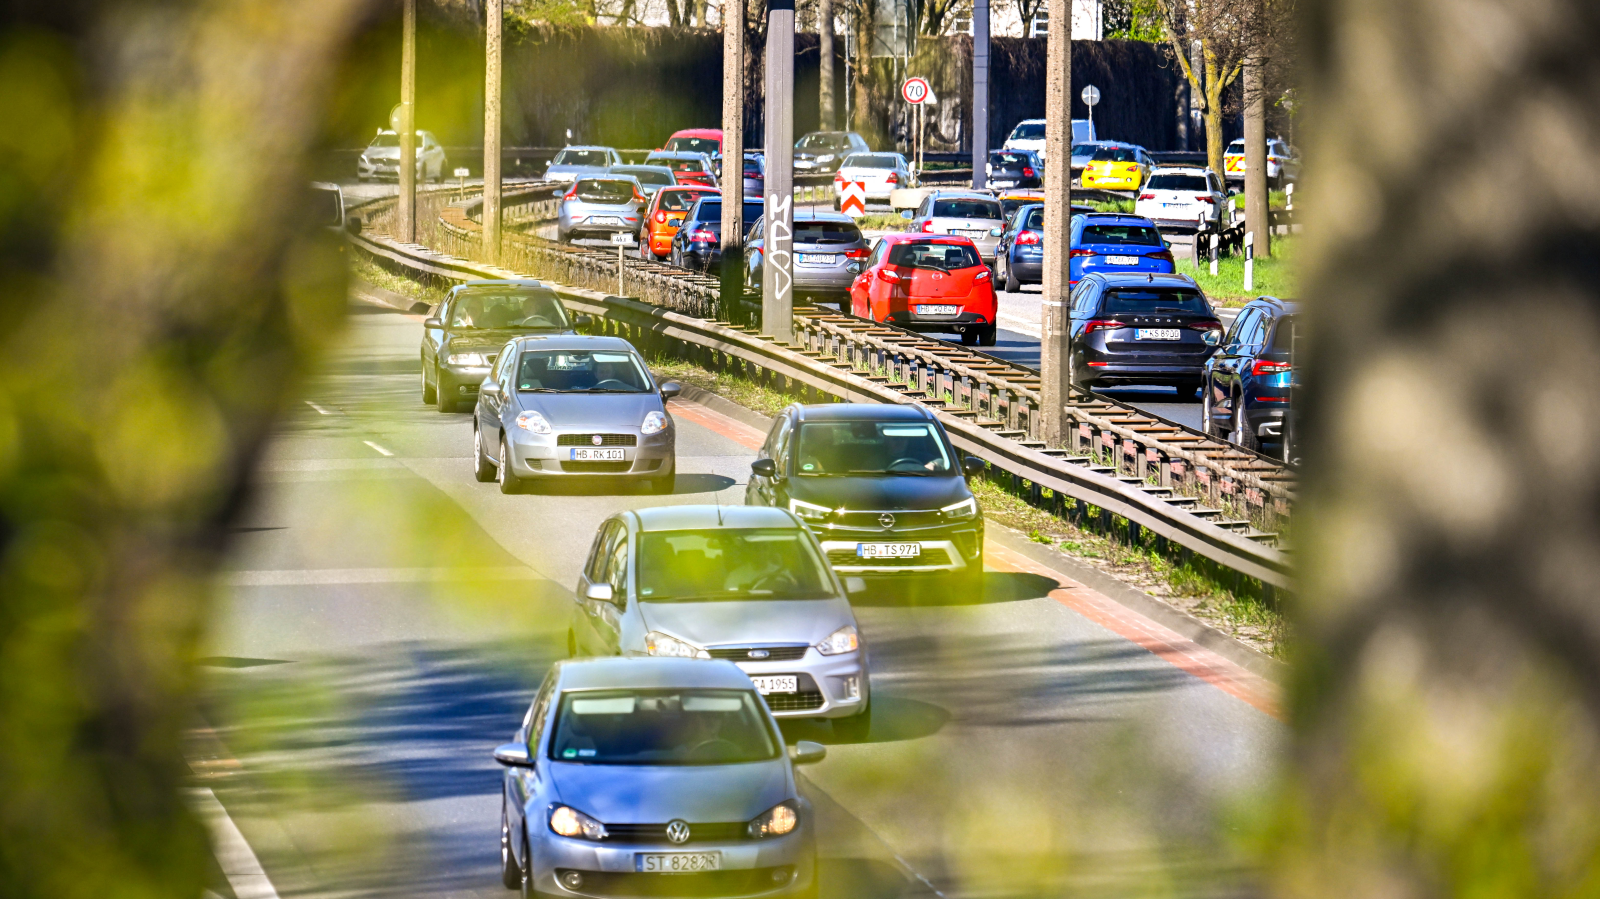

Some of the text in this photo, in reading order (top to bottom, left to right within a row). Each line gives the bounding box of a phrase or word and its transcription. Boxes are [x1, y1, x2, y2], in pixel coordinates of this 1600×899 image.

[908, 85, 923, 97] 70
[1149, 329, 1159, 338] KS
[576, 450, 623, 459] HB RK 101
[863, 545, 919, 555] HB TS 971
[752, 678, 795, 690] CA 1955
[646, 855, 666, 871] ST
